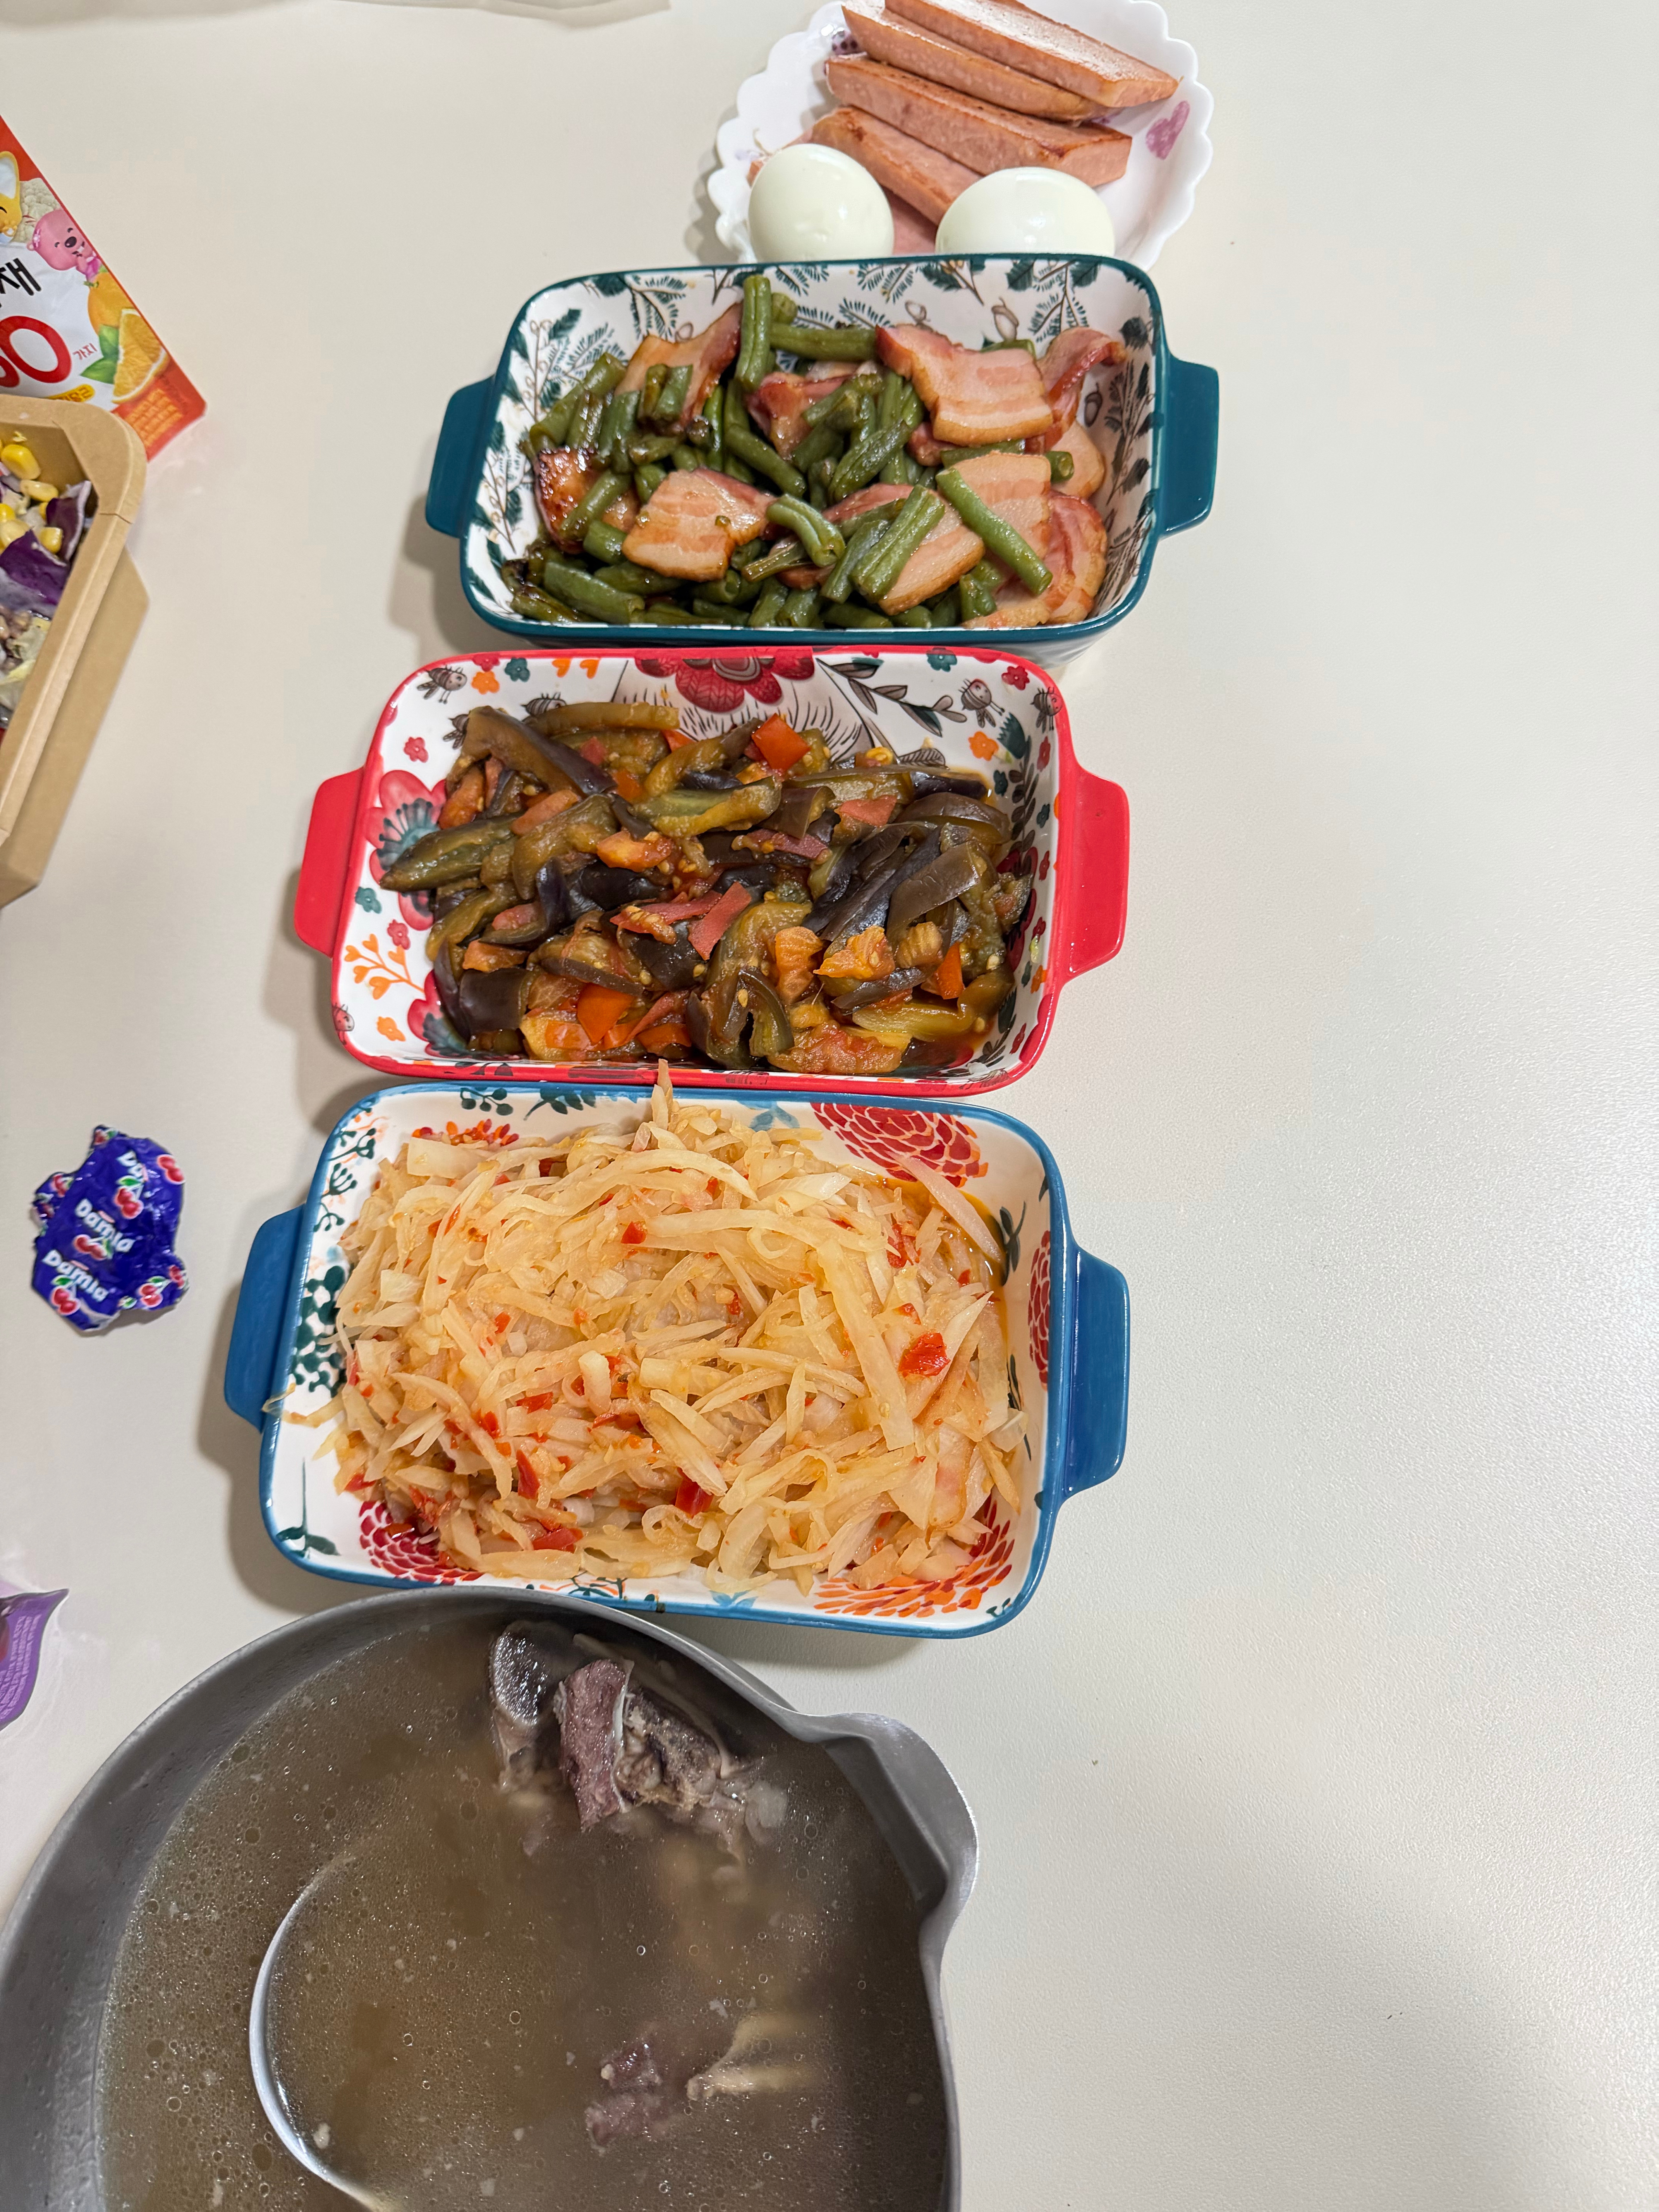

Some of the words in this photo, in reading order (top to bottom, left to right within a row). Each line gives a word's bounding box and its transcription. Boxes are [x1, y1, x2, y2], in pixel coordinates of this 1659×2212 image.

[73, 343, 97, 360] 가지
[75, 1199, 136, 1252] Damla
[42, 1250, 109, 1302] Damla
